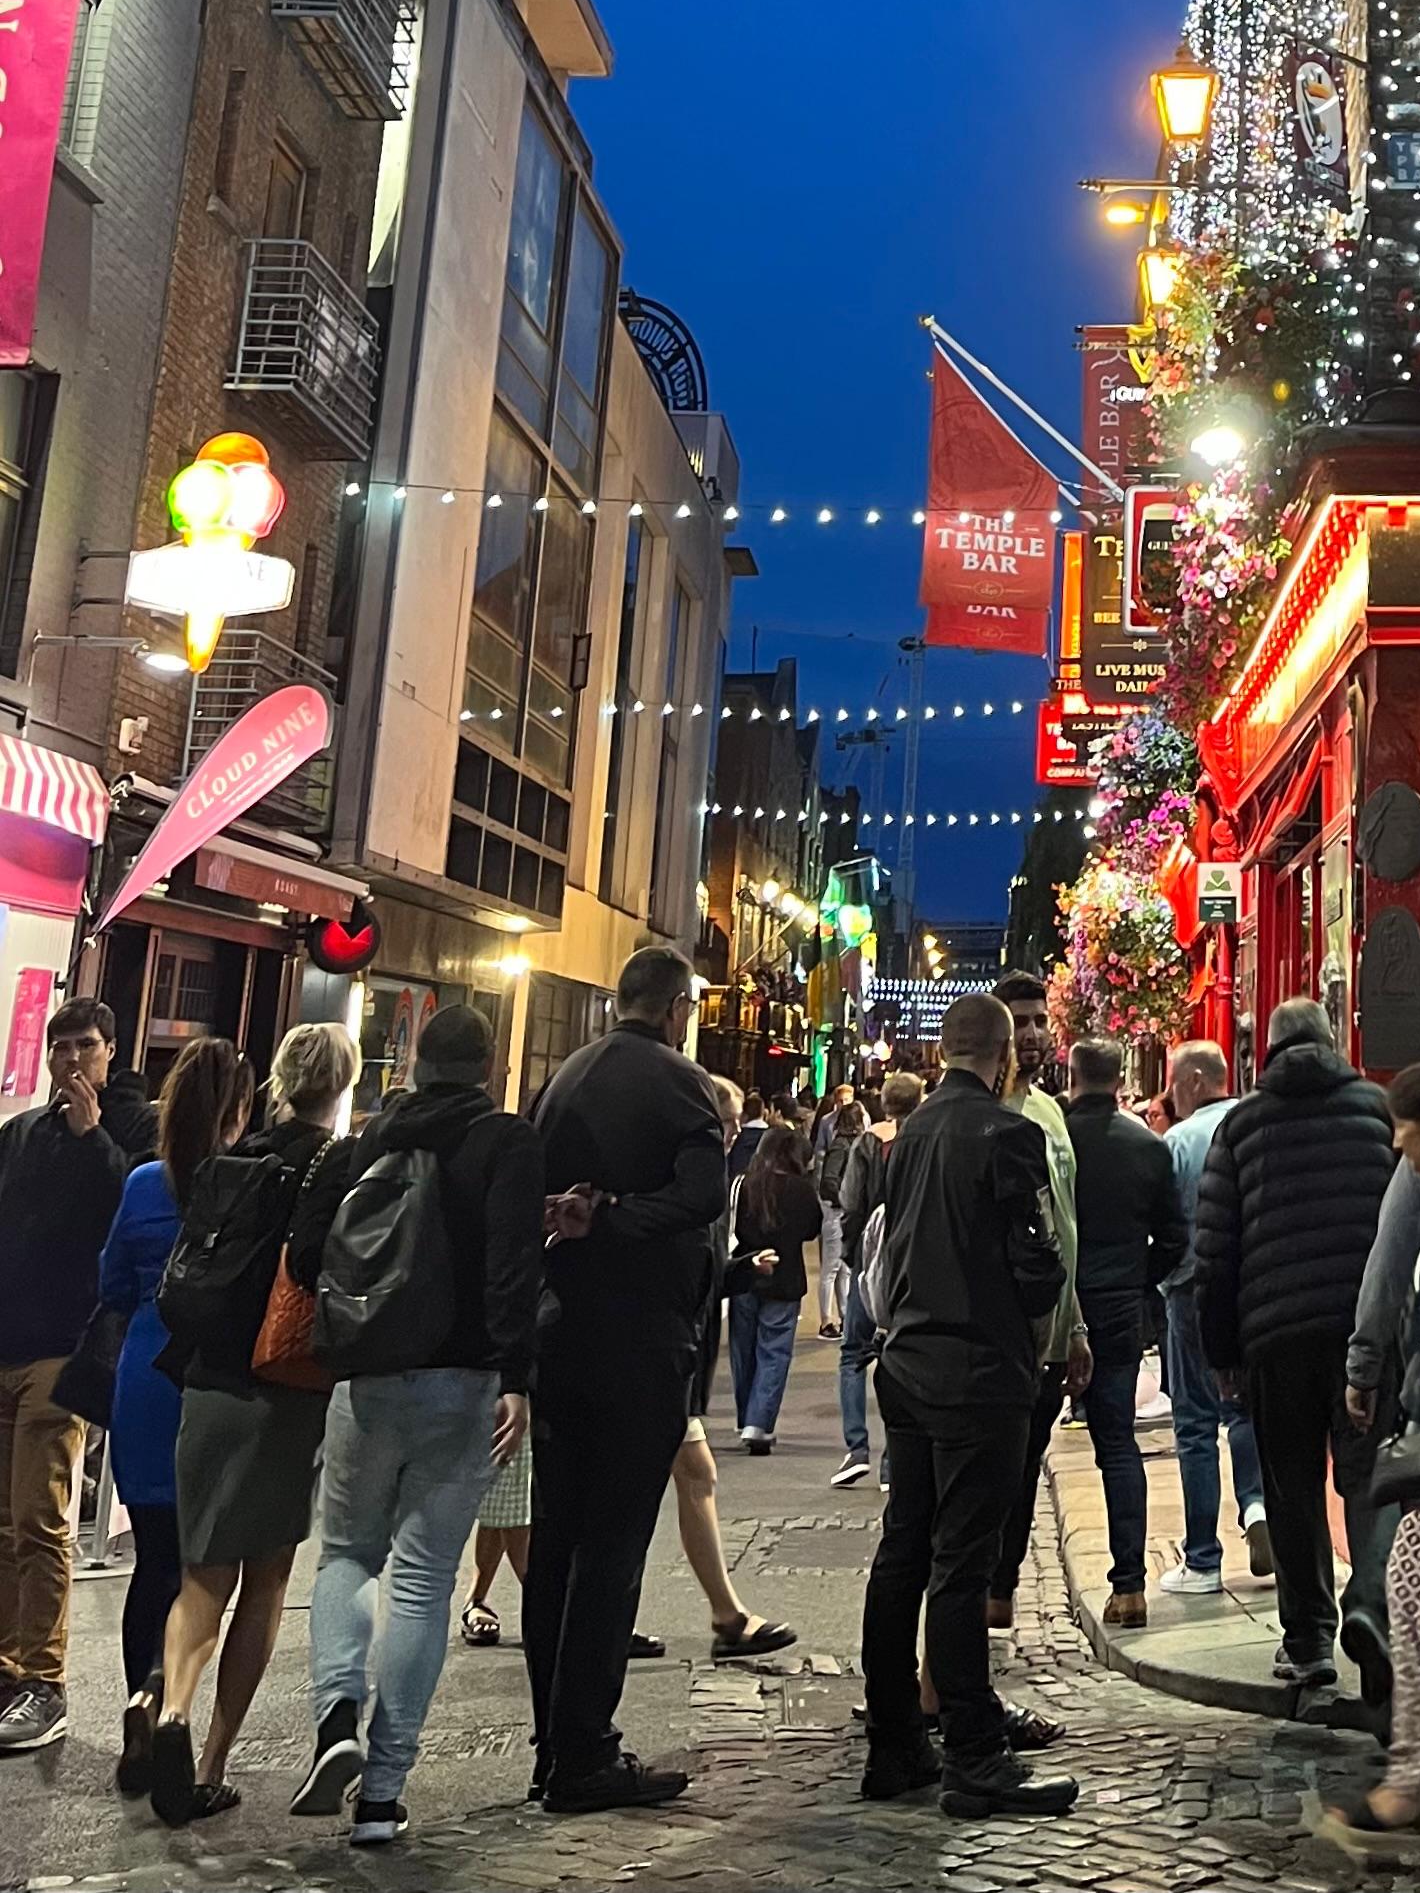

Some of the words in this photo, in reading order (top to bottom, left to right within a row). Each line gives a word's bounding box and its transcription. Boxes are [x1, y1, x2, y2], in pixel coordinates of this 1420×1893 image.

[1100, 372, 1121, 427] BAR
[970, 514, 1015, 534] THE
[935, 527, 1046, 558] TEMPLE
[962, 552, 1020, 576] BAR
[1095, 664, 1132, 677] LIVE
[1133, 664, 1167, 677] MUS
[1055, 679, 1082, 691] THE
[186, 751, 258, 819] CLOUD
[261, 701, 318, 755] NINE
